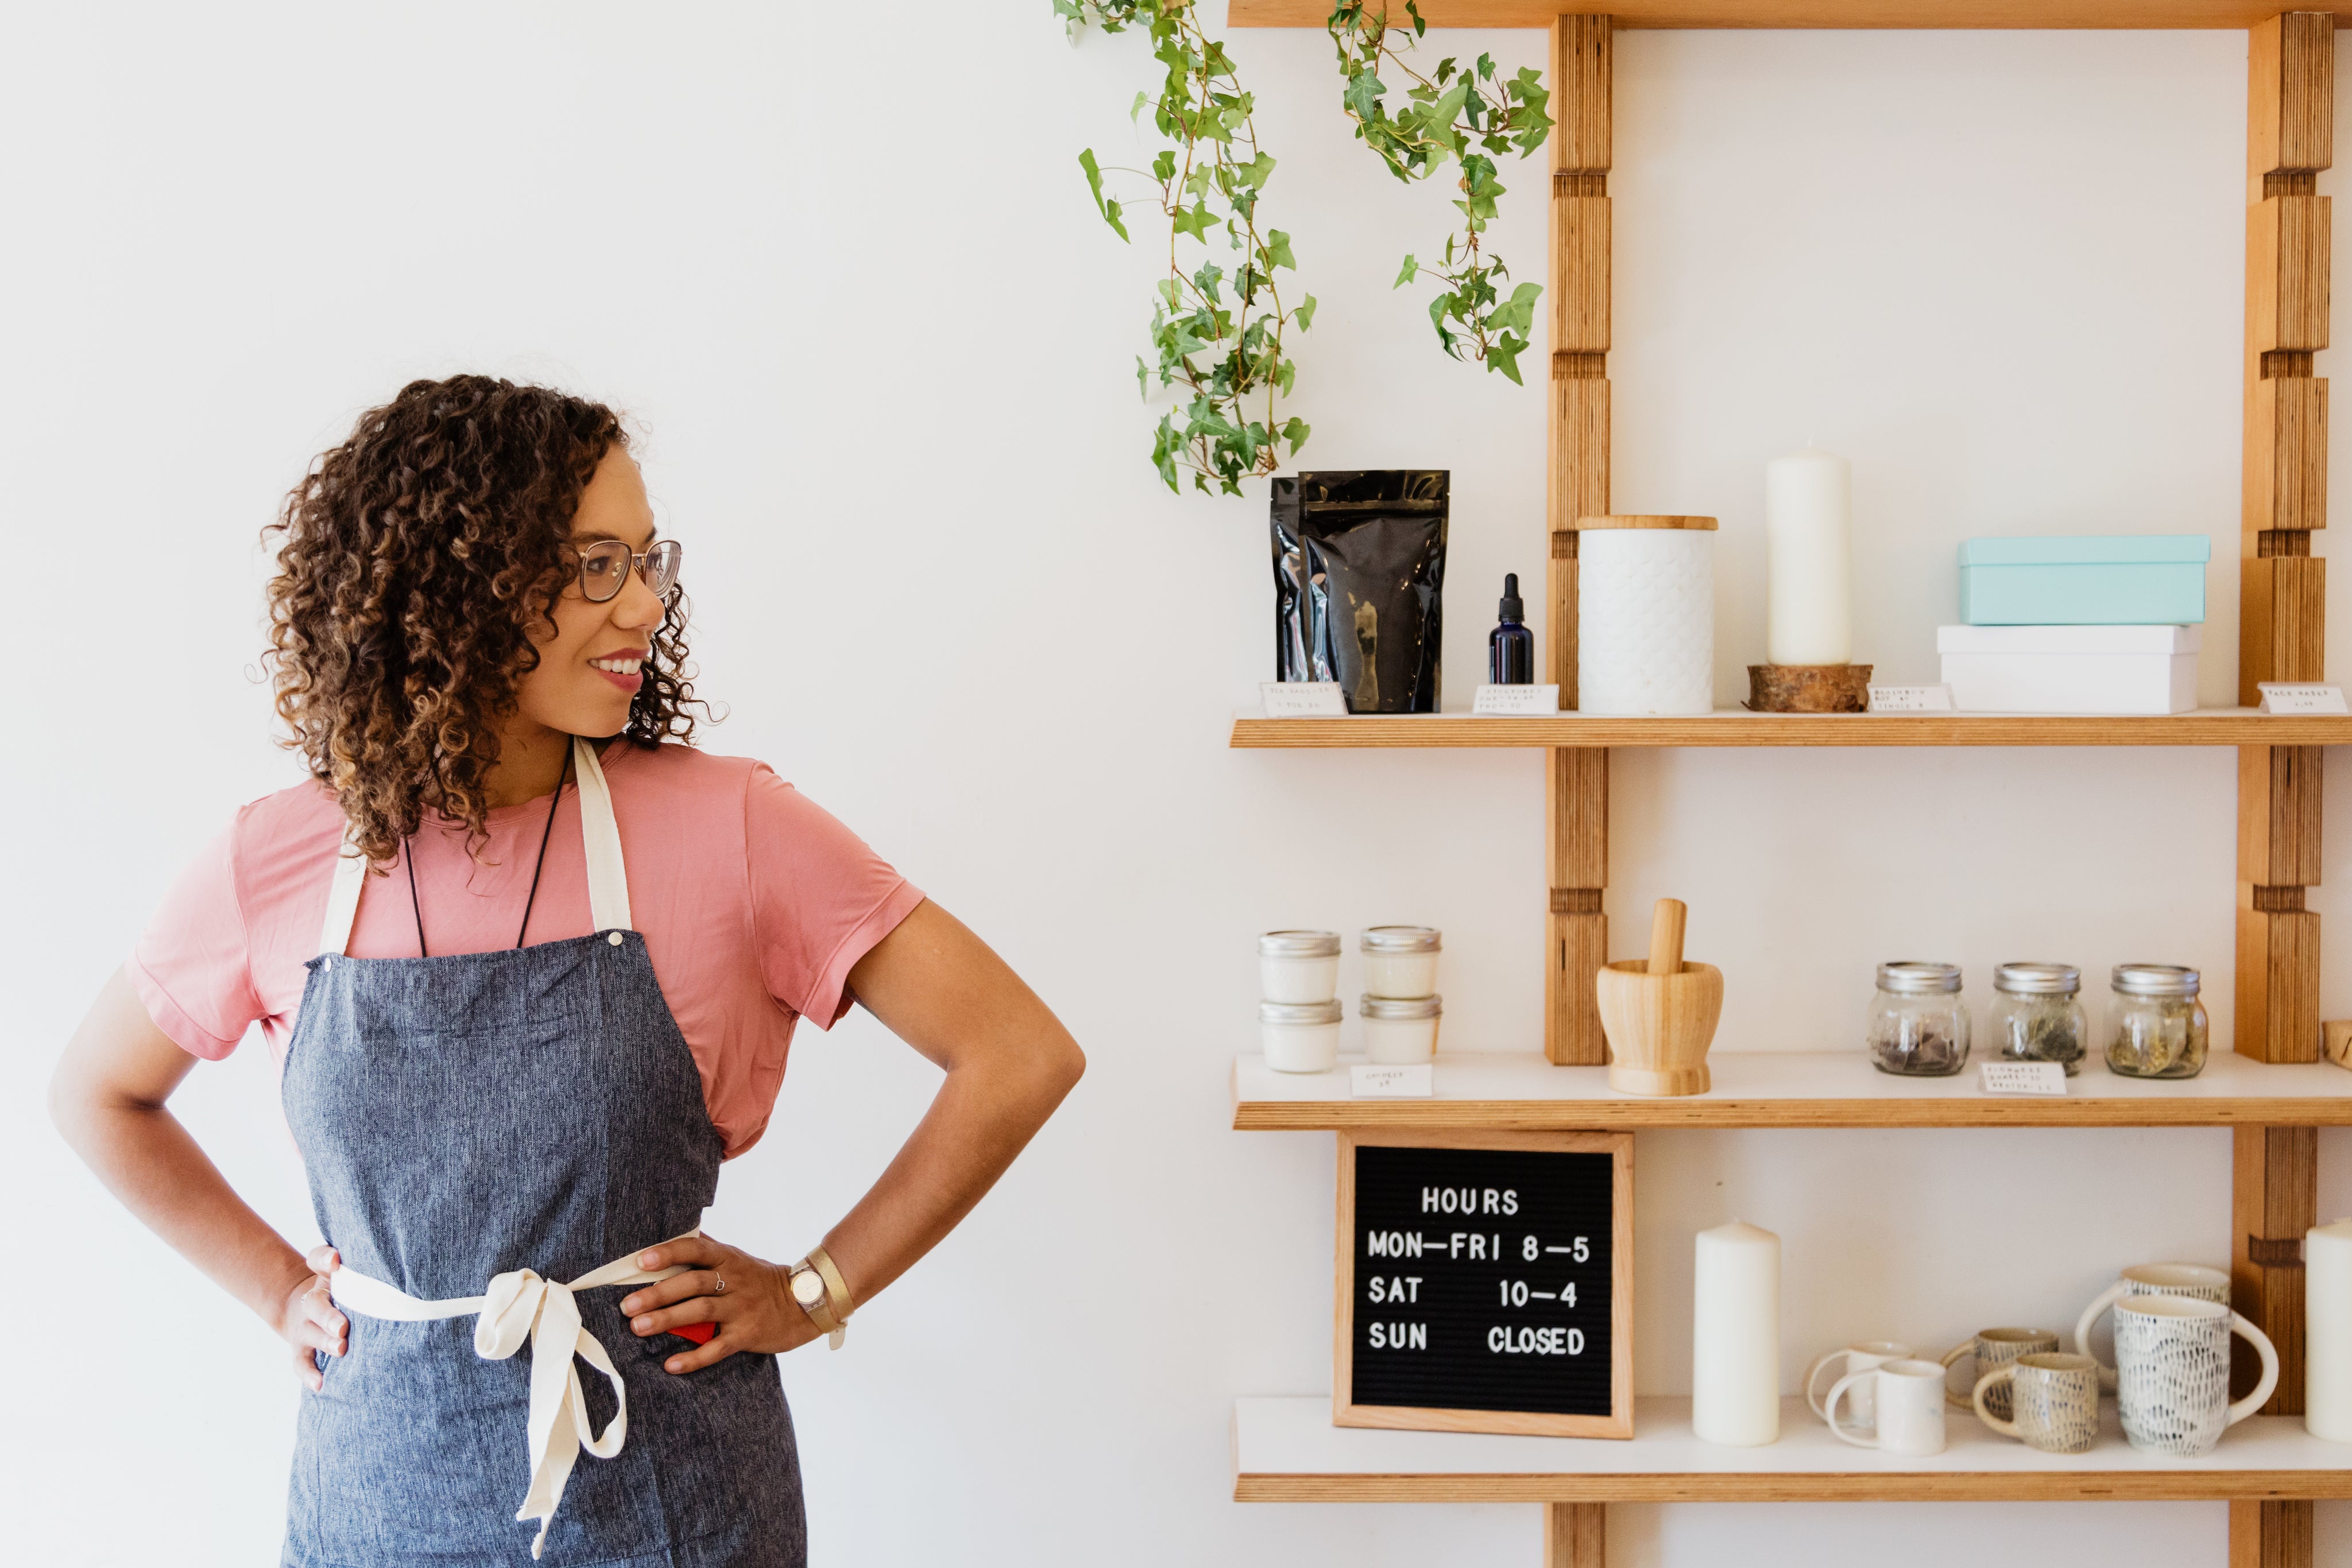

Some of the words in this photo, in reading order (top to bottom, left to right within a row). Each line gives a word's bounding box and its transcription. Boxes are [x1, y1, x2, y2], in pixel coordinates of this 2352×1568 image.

[1422, 1186, 1519, 1216] HOURS
[1368, 1276, 1423, 1304] SAT
[1368, 1322, 1427, 1350] SUN
[1487, 1326, 1585, 1355] CLOSED
